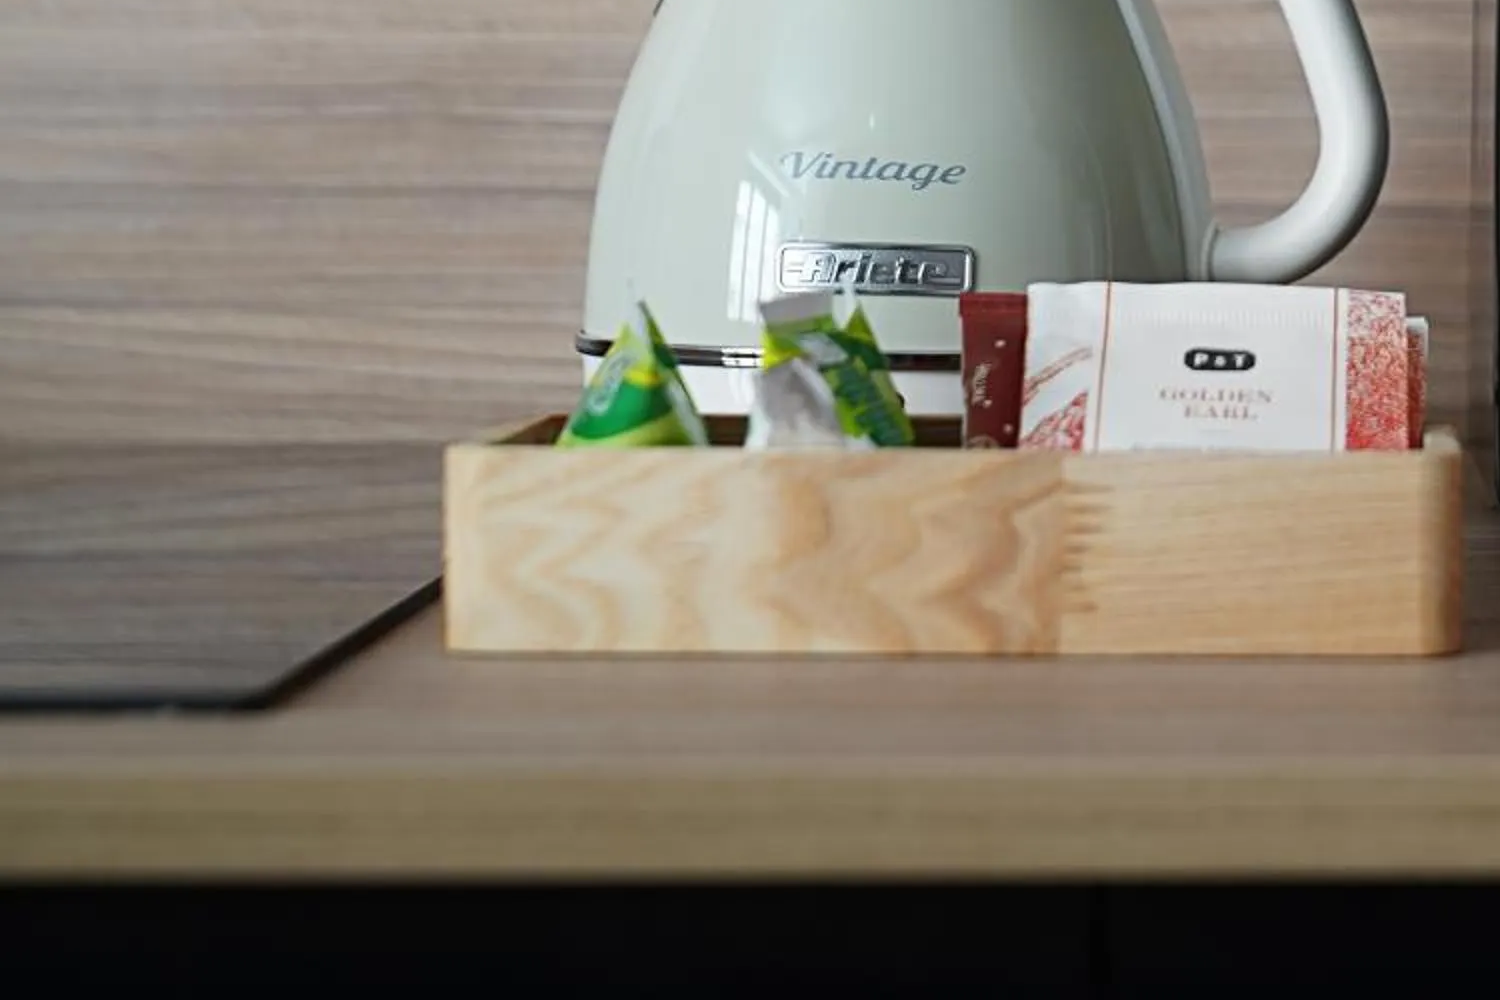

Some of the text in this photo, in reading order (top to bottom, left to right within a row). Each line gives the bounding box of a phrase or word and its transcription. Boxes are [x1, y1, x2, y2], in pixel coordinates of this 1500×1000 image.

[779, 150, 967, 191] Vintage
[1157, 386, 1273, 404] GOLDEN
[1182, 405, 1258, 421] EARL
